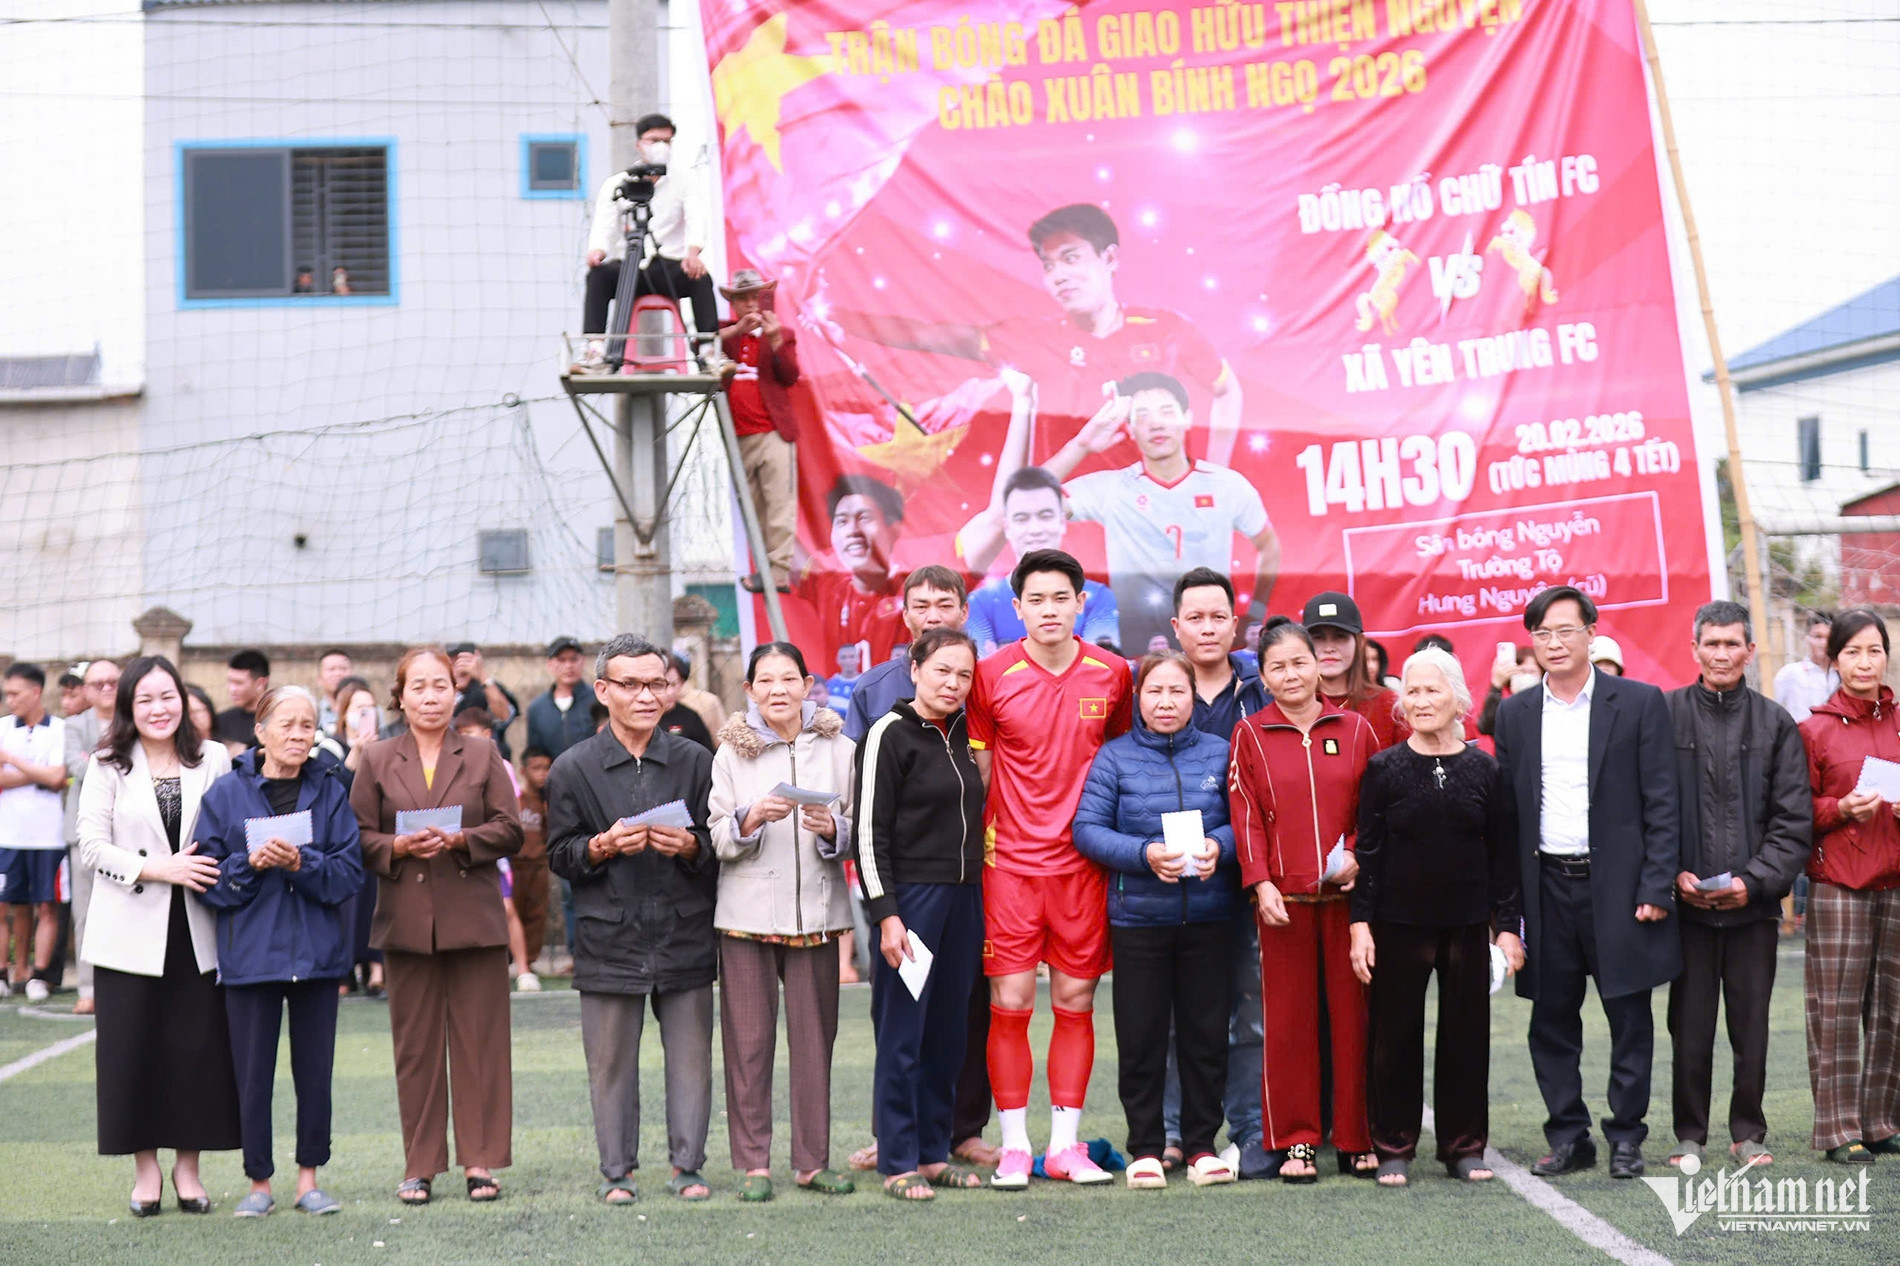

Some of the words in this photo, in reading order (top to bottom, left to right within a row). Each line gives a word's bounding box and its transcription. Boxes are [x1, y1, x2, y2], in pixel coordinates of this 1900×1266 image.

[825, 20, 919, 84] TRẬN
[931, 15, 1027, 71] BÓNG
[1037, 6, 1087, 64] ĐÁ
[1097, 10, 1179, 59] GIAO
[938, 72, 1033, 130] CHÀO
[1045, 62, 1138, 123] XUÂN
[1150, 59, 1235, 116] BÍNH
[1245, 59, 1317, 114] NGỌ
[1329, 49, 1427, 101] 2026
[1298, 182, 1386, 234] ĐỒNG
[1508, 154, 1559, 206] TÍN
[1561, 154, 1599, 196] FC
[1428, 252, 1484, 301] VS
[1342, 343, 1389, 393] XÃ
[1392, 337, 1455, 387] YÊN
[1458, 327, 1554, 379] TRUNG
[1557, 322, 1599, 364] FC
[1515, 410, 1645, 453] 20.02.2026
[1296, 430, 1476, 516] 14H30
[1613, 447, 1632, 477] 4
[1456, 526, 1516, 551] bóng
[1517, 510, 1601, 547] Nguyễn
[1533, 548, 1563, 574] Tộ
